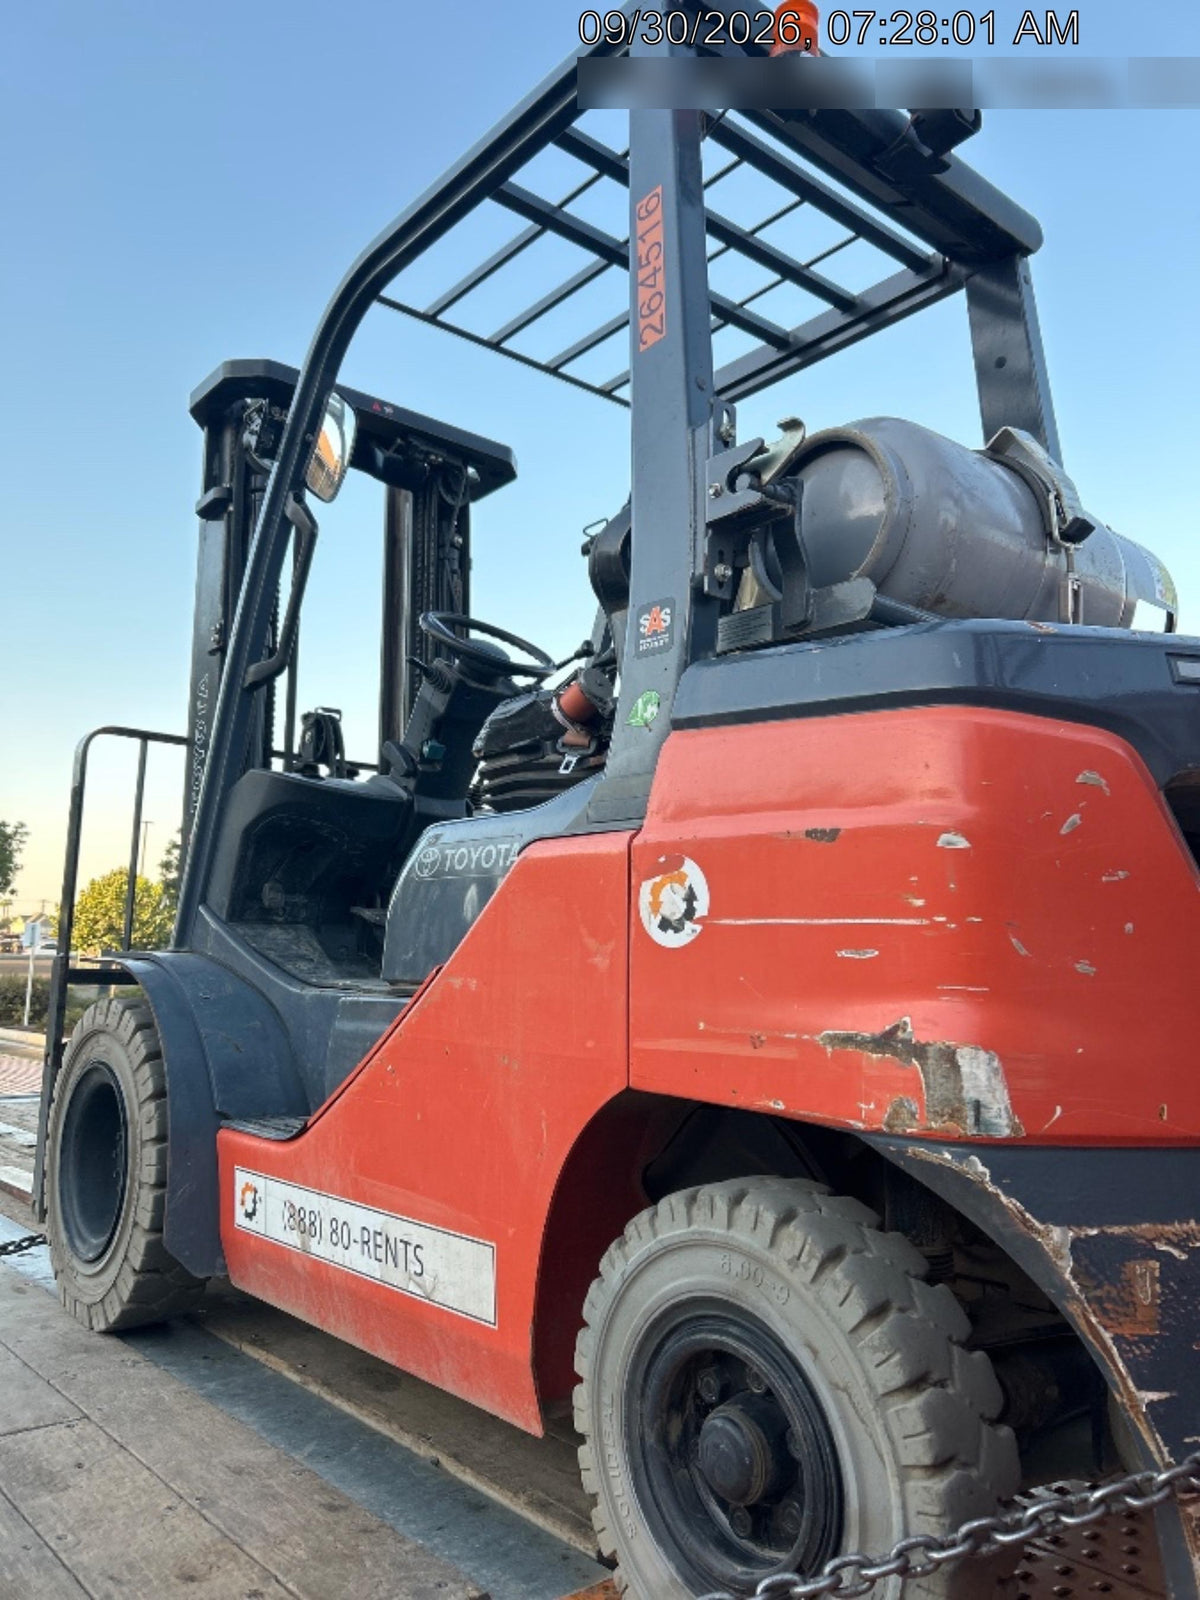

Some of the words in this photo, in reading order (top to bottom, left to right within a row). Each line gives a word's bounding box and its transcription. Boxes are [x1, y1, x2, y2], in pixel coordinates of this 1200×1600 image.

[637, 191, 664, 346] 264516
[639, 605, 671, 636] SAS
[444, 842, 520, 872] TOYOTA
[282, 1200, 323, 1245] (888)
[329, 1216, 425, 1278] 80-RENTS
